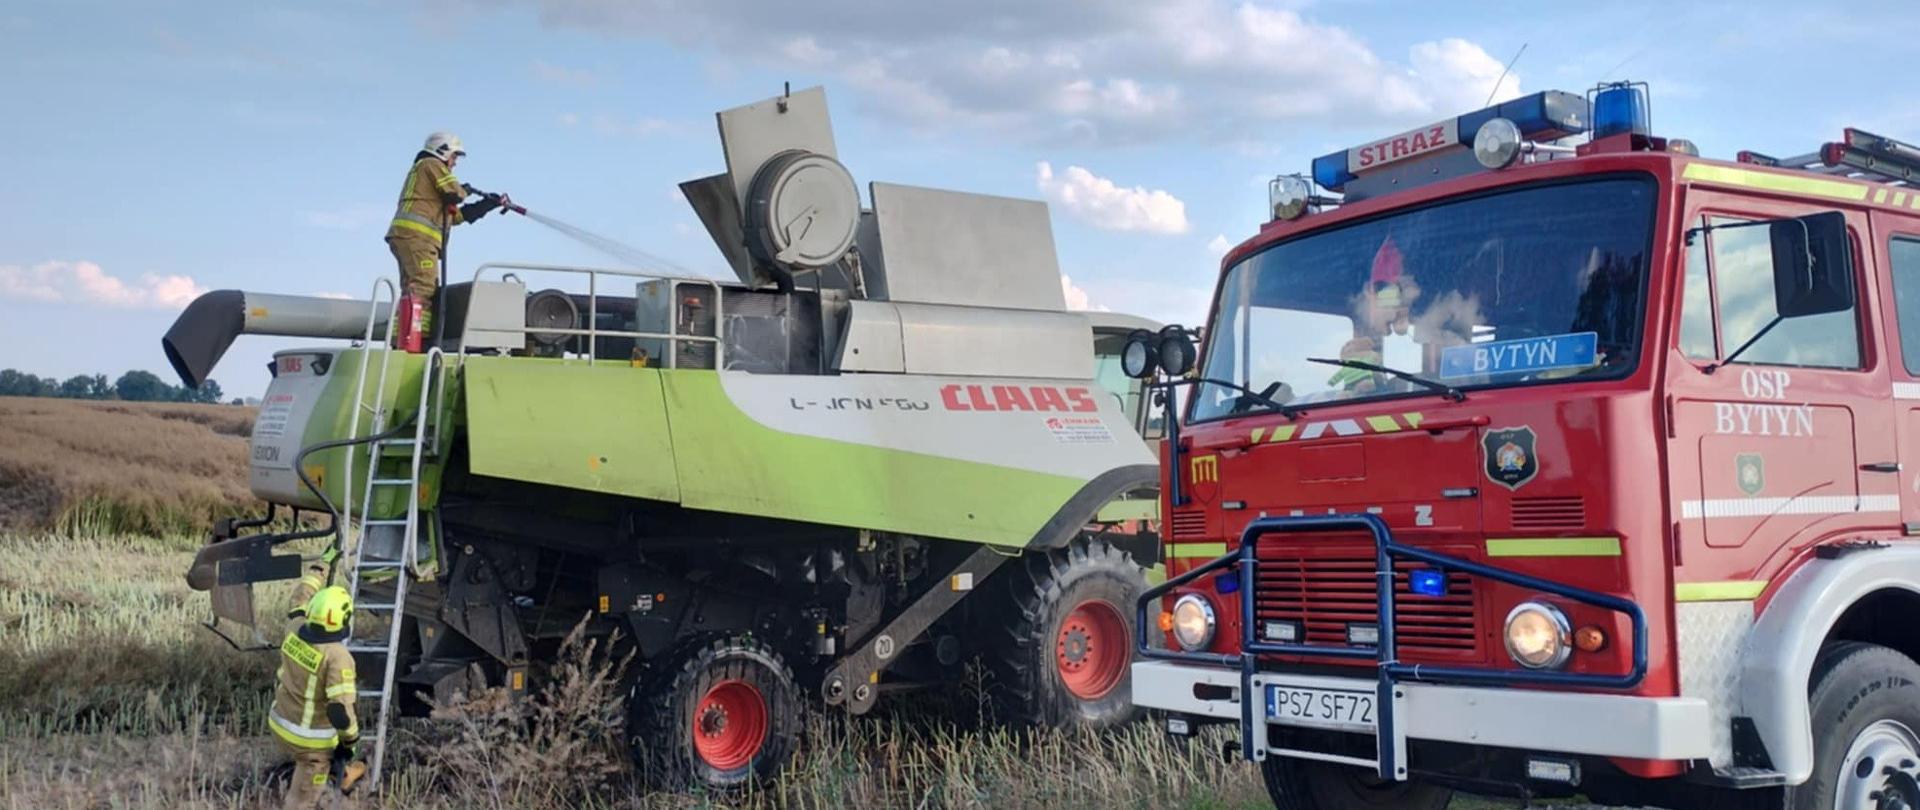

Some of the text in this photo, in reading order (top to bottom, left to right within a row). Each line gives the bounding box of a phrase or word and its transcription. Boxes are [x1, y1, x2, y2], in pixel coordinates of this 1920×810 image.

[1359, 125, 1446, 167] STRAŻ
[1473, 338, 1557, 372] BYTYŃ
[939, 384, 1098, 412] CLAAS
[1741, 368, 1791, 400] OSP
[1714, 401, 1815, 437] BYTYŃ
[1278, 690, 1372, 722] PSZ SF72
